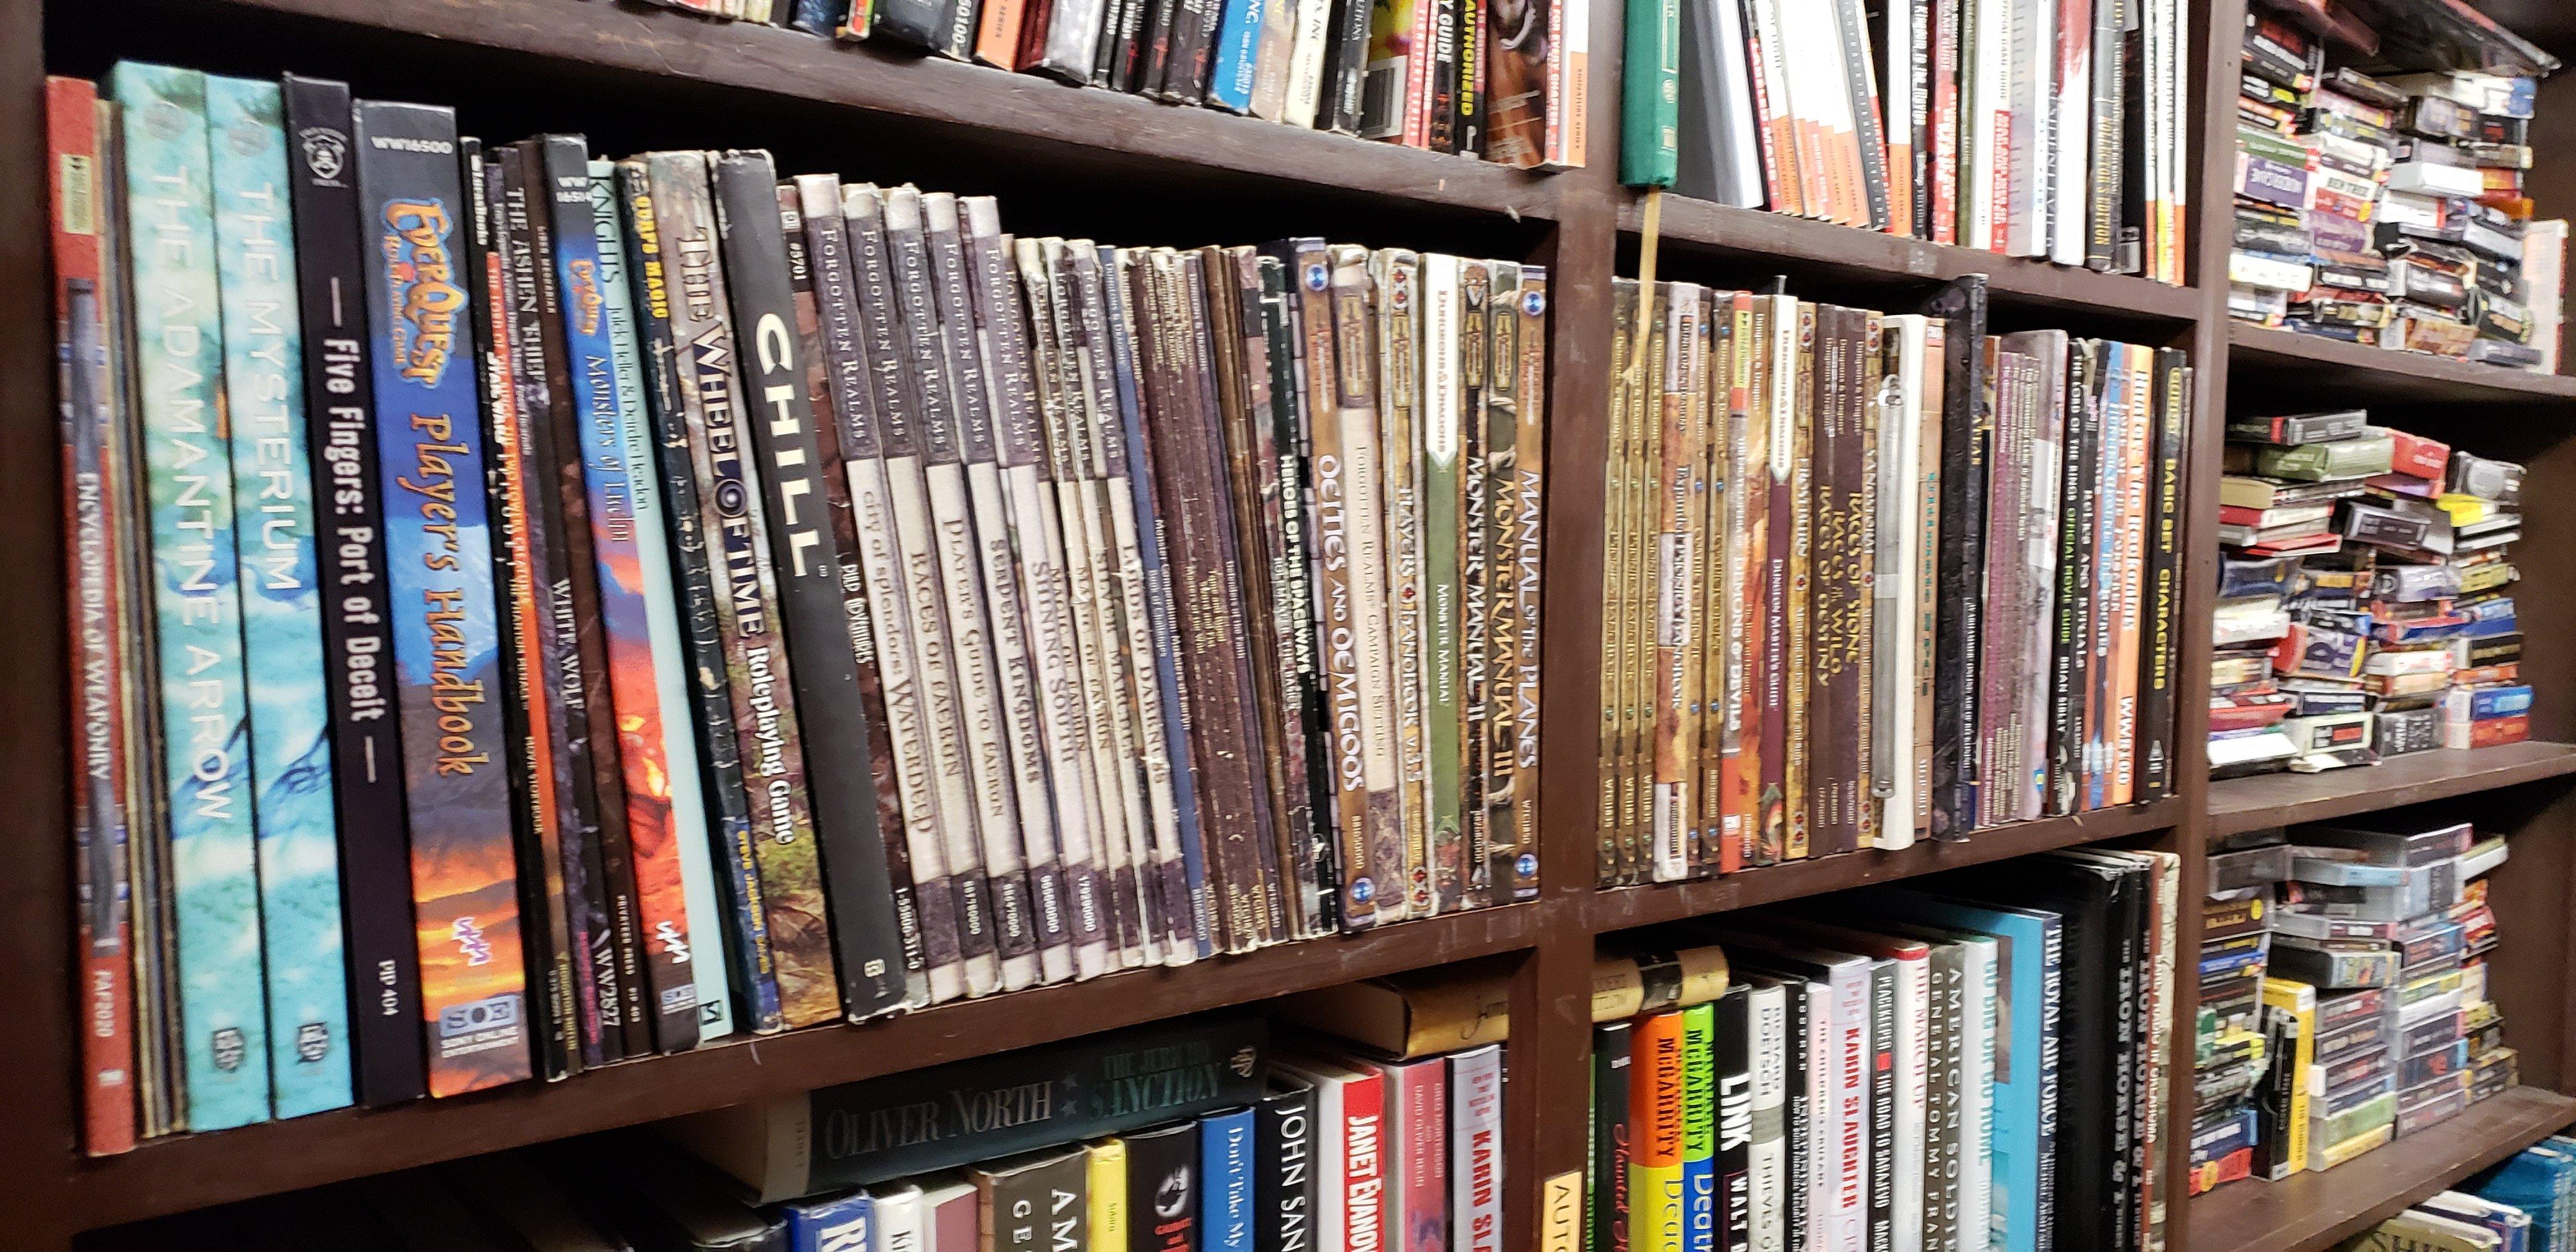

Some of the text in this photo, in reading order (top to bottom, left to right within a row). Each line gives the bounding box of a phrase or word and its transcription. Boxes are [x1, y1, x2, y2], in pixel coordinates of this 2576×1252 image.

[1436, 14, 1453, 63] GUIDE
[371, 135, 454, 155] WW16500
[505, 187, 526, 231] THE
[588, 174, 619, 284] KNIGHTS
[632, 197, 669, 318] GURPS MAGIC
[513, 241, 539, 313] ASHEN
[675, 226, 714, 323] THE
[820, 229, 865, 439] FORGOTTEN REALMS
[861, 229, 904, 438] FORGOTTEN REALMS
[903, 241, 946, 445] FORGOTTEN REALMS
[943, 243, 986, 443] FORGOTTEN REALMS
[238, 183, 300, 591] THE MYSTERIUM
[585, 355, 618, 447] Monsters
[692, 323, 737, 478] WHEEL
[150, 166, 232, 819] THE ADAMANTINE ARROW
[589, 455, 622, 473] of
[755, 313, 821, 576] CHILL
[323, 339, 385, 722] Five Fingers: Port of Deceit
[862, 491, 884, 533] city
[868, 538, 887, 561] of
[1285, 521, 1301, 542] OF
[395, 413, 486, 778] Player's Handbook
[726, 541, 766, 639] TIME
[840, 564, 860, 595] PULP
[1466, 455, 1486, 722] MONSTER MANUAL II
[1517, 470, 1539, 769] MANUAL PLANES
[2153, 458, 2176, 690] BASIC SET CHARACTERS
[77, 472, 111, 781] ENCYCLOPEDIA OF WEAPONRY
[551, 579, 585, 712] WHITE WOLF
[988, 538, 1039, 784] SERPENT KINGDOMS
[1032, 561, 1075, 764] SHINING SOUTH
[1133, 629, 1147, 653] OF
[1291, 579, 1310, 673] SPACEWAYS
[1318, 455, 1365, 792] DEITIES AND DEMIGODS
[1490, 478, 1515, 777] MONSTER MANUAL III
[745, 647, 787, 778] Roleplaying
[1438, 650, 1450, 705] MANUAL
[885, 676, 934, 834] WATERDEEP
[769, 780, 797, 846] Game
[742, 874, 762, 933] JACKSON
[378, 959, 398, 1016] PIP 404
[595, 948, 620, 1027] WW2827
[2041, 925, 2062, 1137] THE ROYAL AIR FORCE
[1874, 975, 1894, 1208] PEACEKEEPER THE ROAD TO SARAJEVO
[1926, 972, 1945, 1179] GENERAL TOMMY
[1946, 966, 1963, 1129] AMERICAN
[2114, 966, 2133, 1152] IRON HORSE
[827, 1080, 1052, 1159] OLIVER NORTH
[1227, 1127, 1245, 1175] Don't
[1273, 1103, 1307, 1187] JOHN
[1348, 1115, 1381, 1177] JANET
[1720, 1071, 1752, 1151] LINK
[1841, 1027, 1861, 1209] KARIN SLAUGHTER
[2147, 1067, 2159, 1143] OKLAHOMA
[1471, 1129, 1494, 1209] KARIN
[1552, 1184, 1571, 1252] AUT
[1730, 1175, 1747, 1232] WALT
[1761, 1152, 1774, 1229] THIEVES
[1223, 1223, 1245, 1248] My
